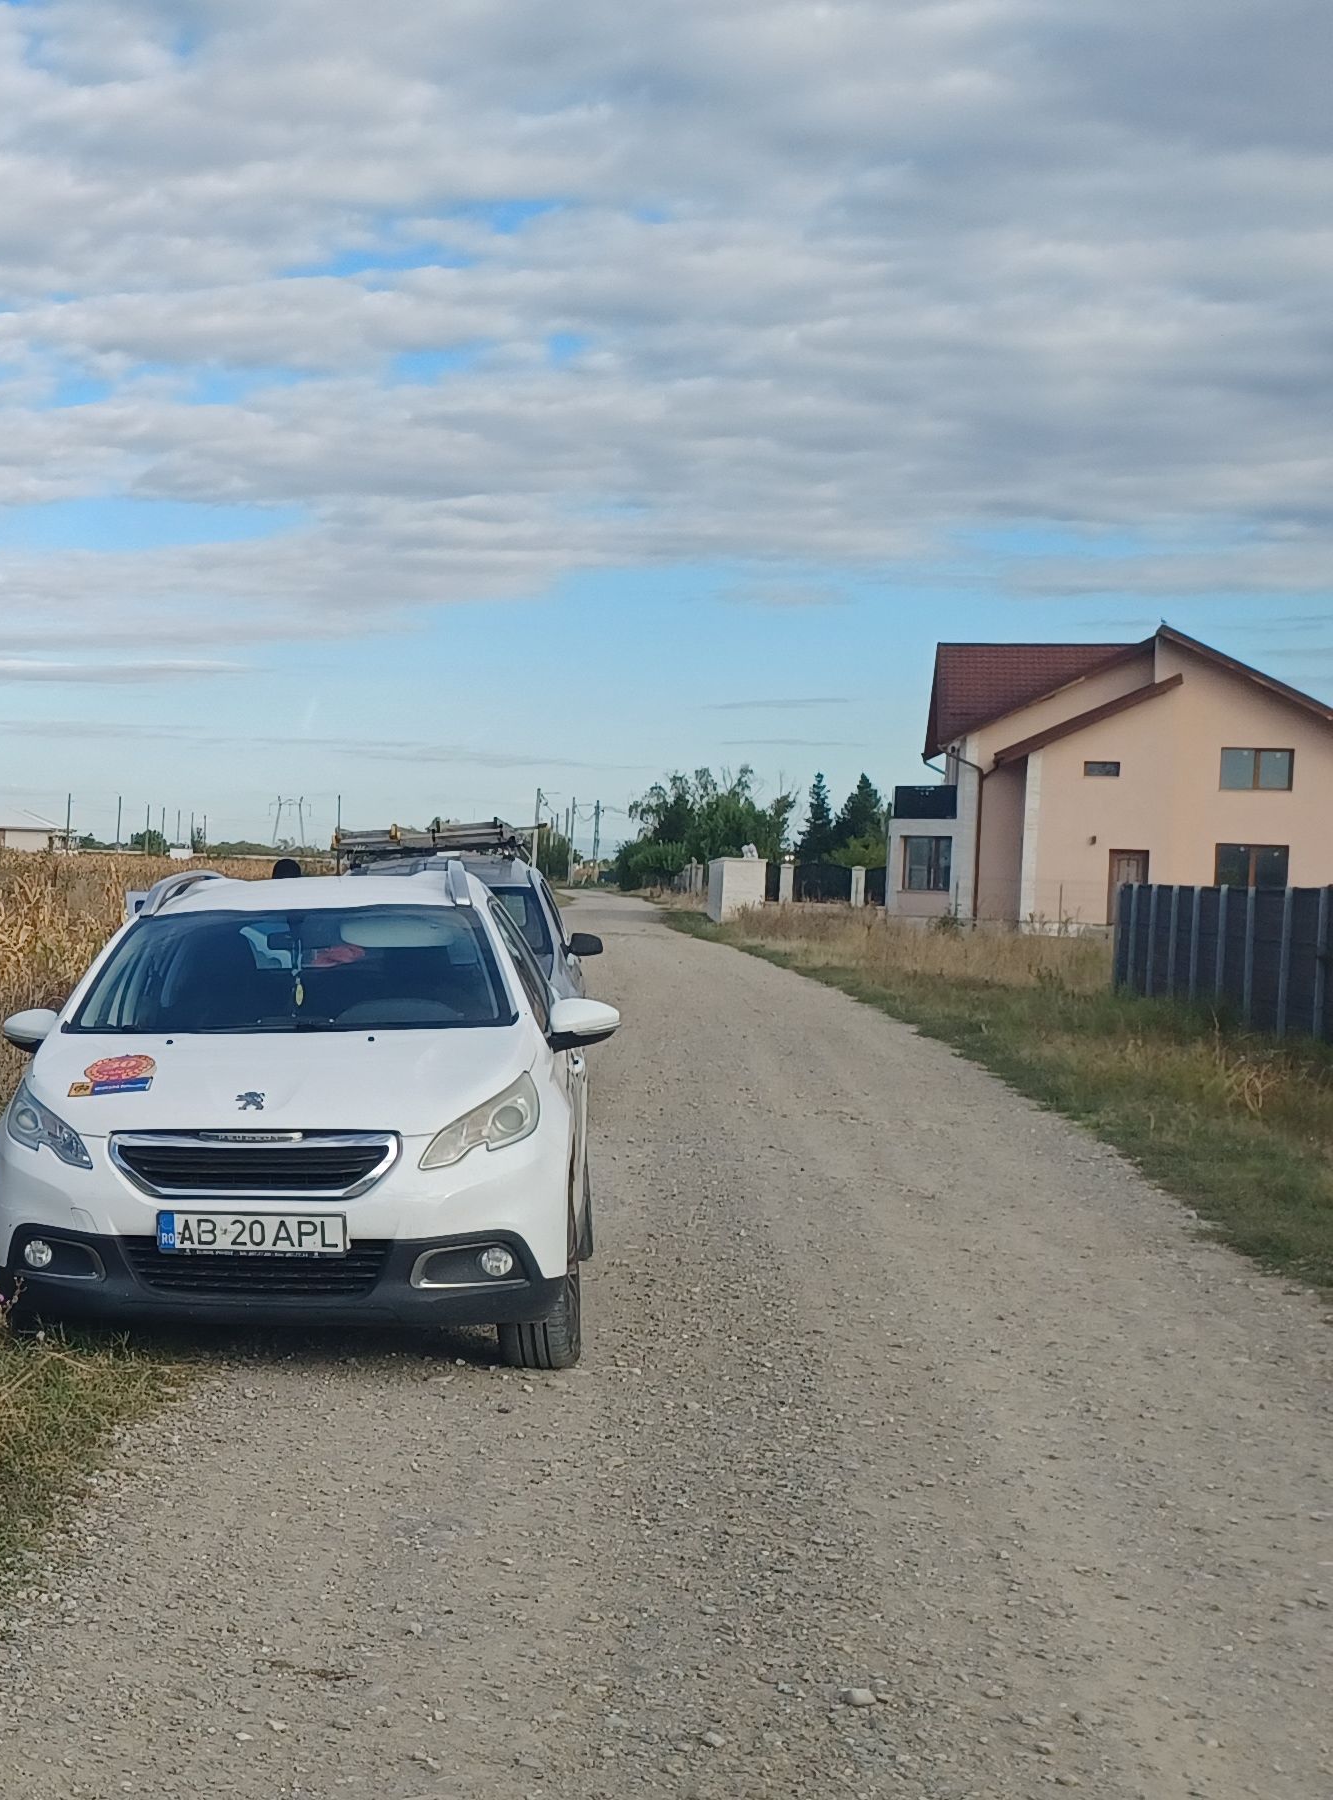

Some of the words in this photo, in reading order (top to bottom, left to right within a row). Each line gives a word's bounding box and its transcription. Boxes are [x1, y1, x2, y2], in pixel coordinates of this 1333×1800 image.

[161, 1232, 175, 1244] RO
[179, 1218, 217, 1246] AB
[230, 1219, 266, 1246] 20
[271, 1220, 339, 1249] APL
